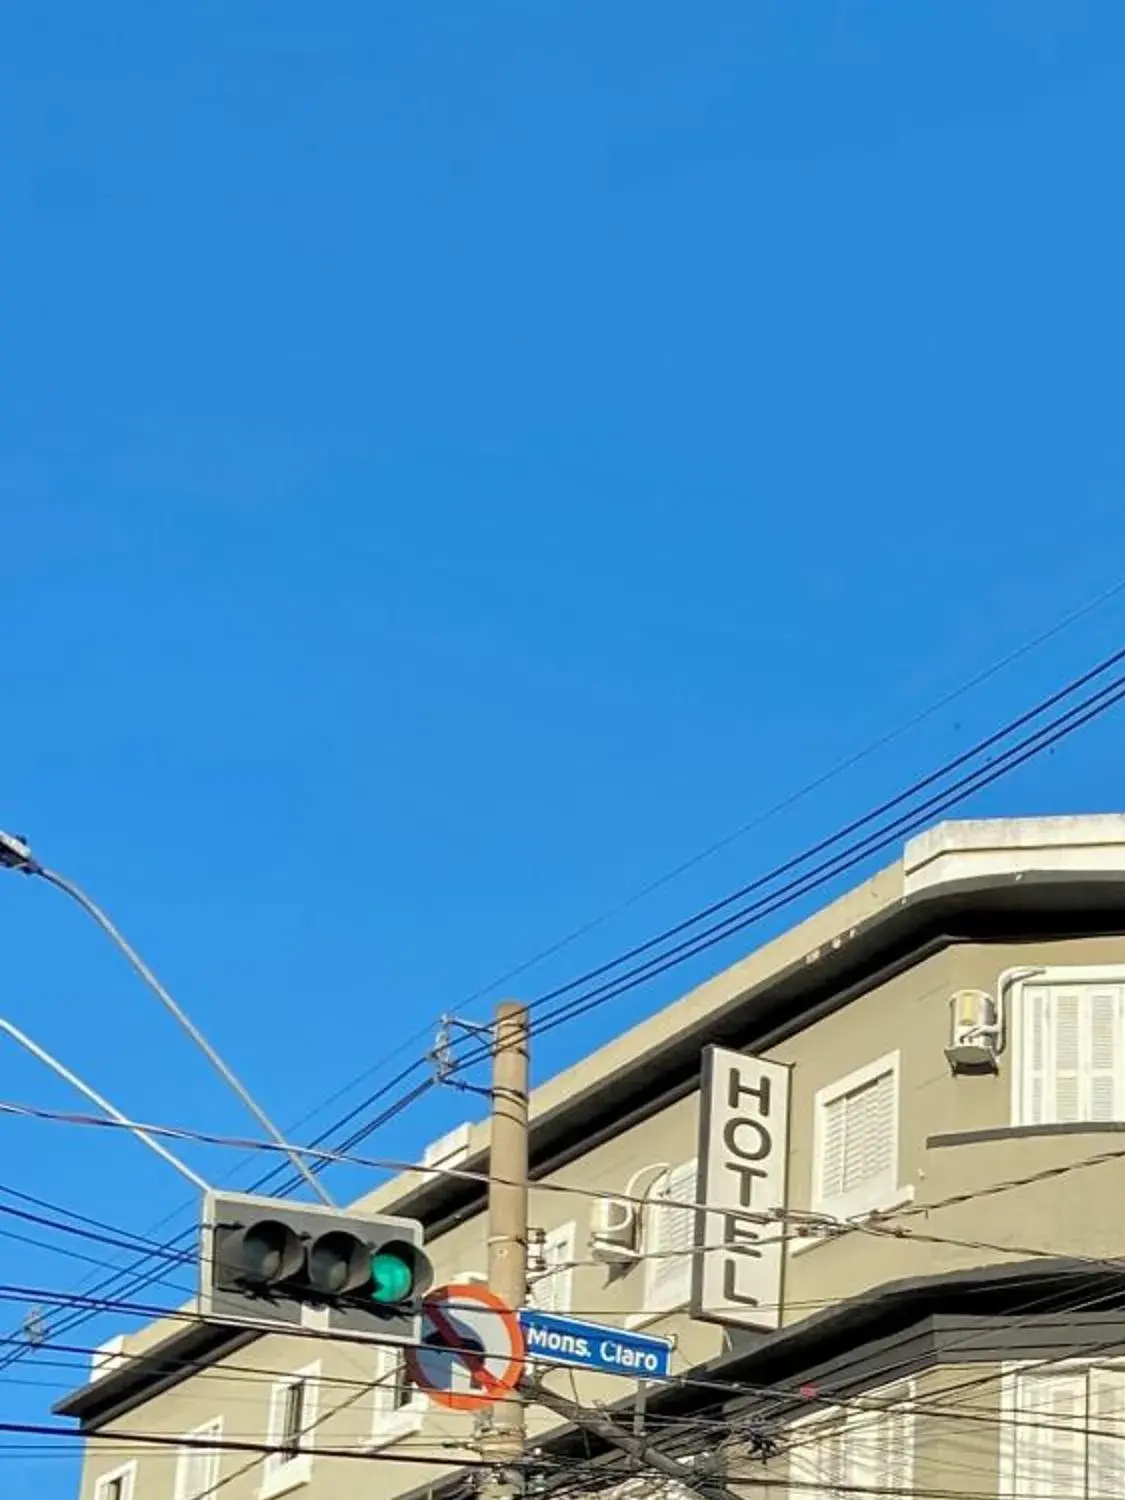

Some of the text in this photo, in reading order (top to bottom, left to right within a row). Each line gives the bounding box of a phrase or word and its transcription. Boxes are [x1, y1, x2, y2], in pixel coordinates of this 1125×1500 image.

[723, 1067, 773, 1308] HOTEL
[527, 1325, 658, 1370] Mons. Claro
